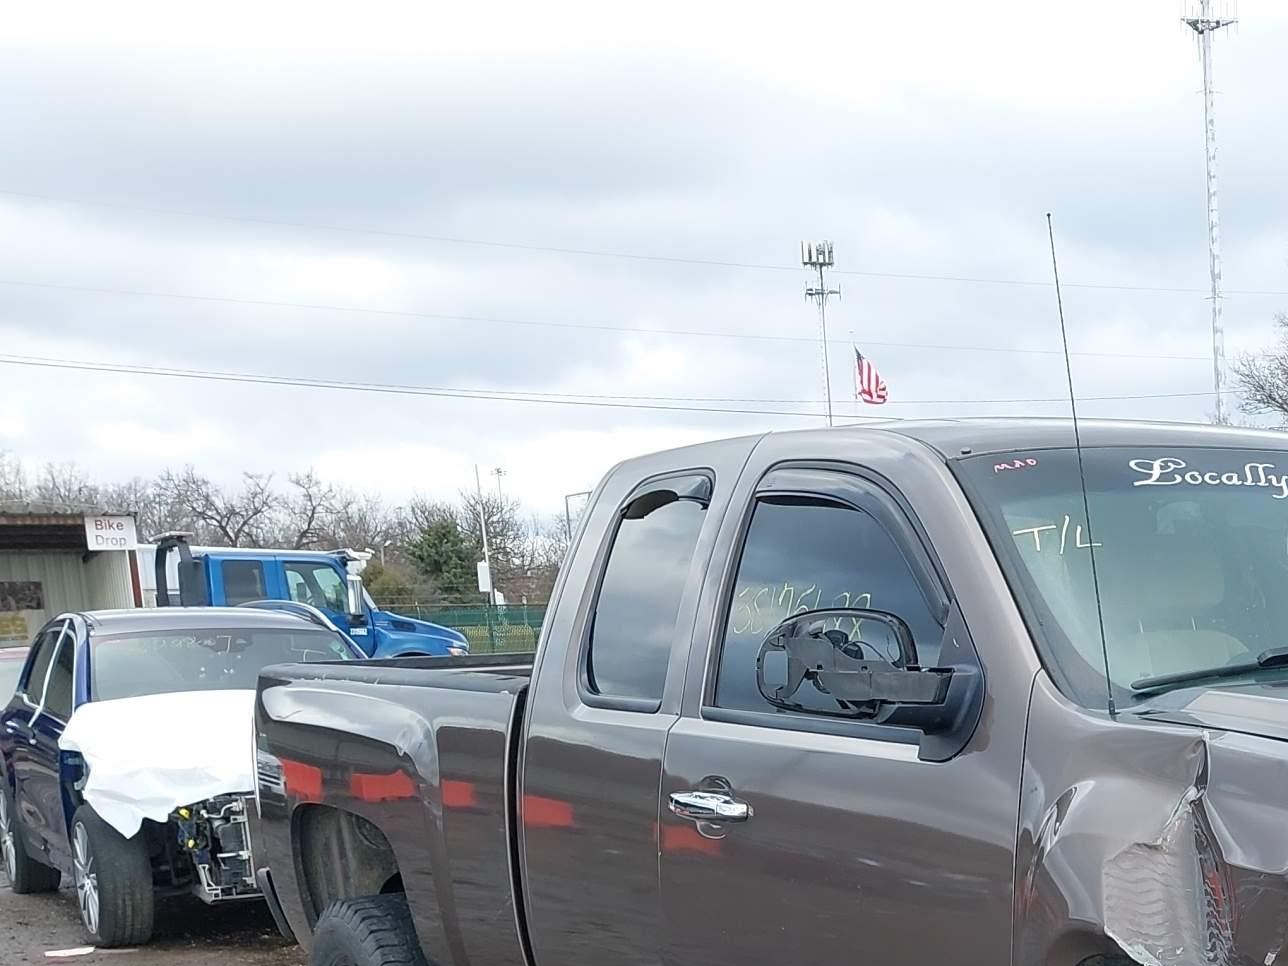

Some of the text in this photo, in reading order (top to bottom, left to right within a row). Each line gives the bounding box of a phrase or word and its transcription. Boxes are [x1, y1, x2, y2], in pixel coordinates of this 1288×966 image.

[1129, 457, 1288, 500] Locally
[95, 519, 125, 531] Bike
[1012, 514, 1103, 555] T/L
[95, 534, 127, 548] Drop
